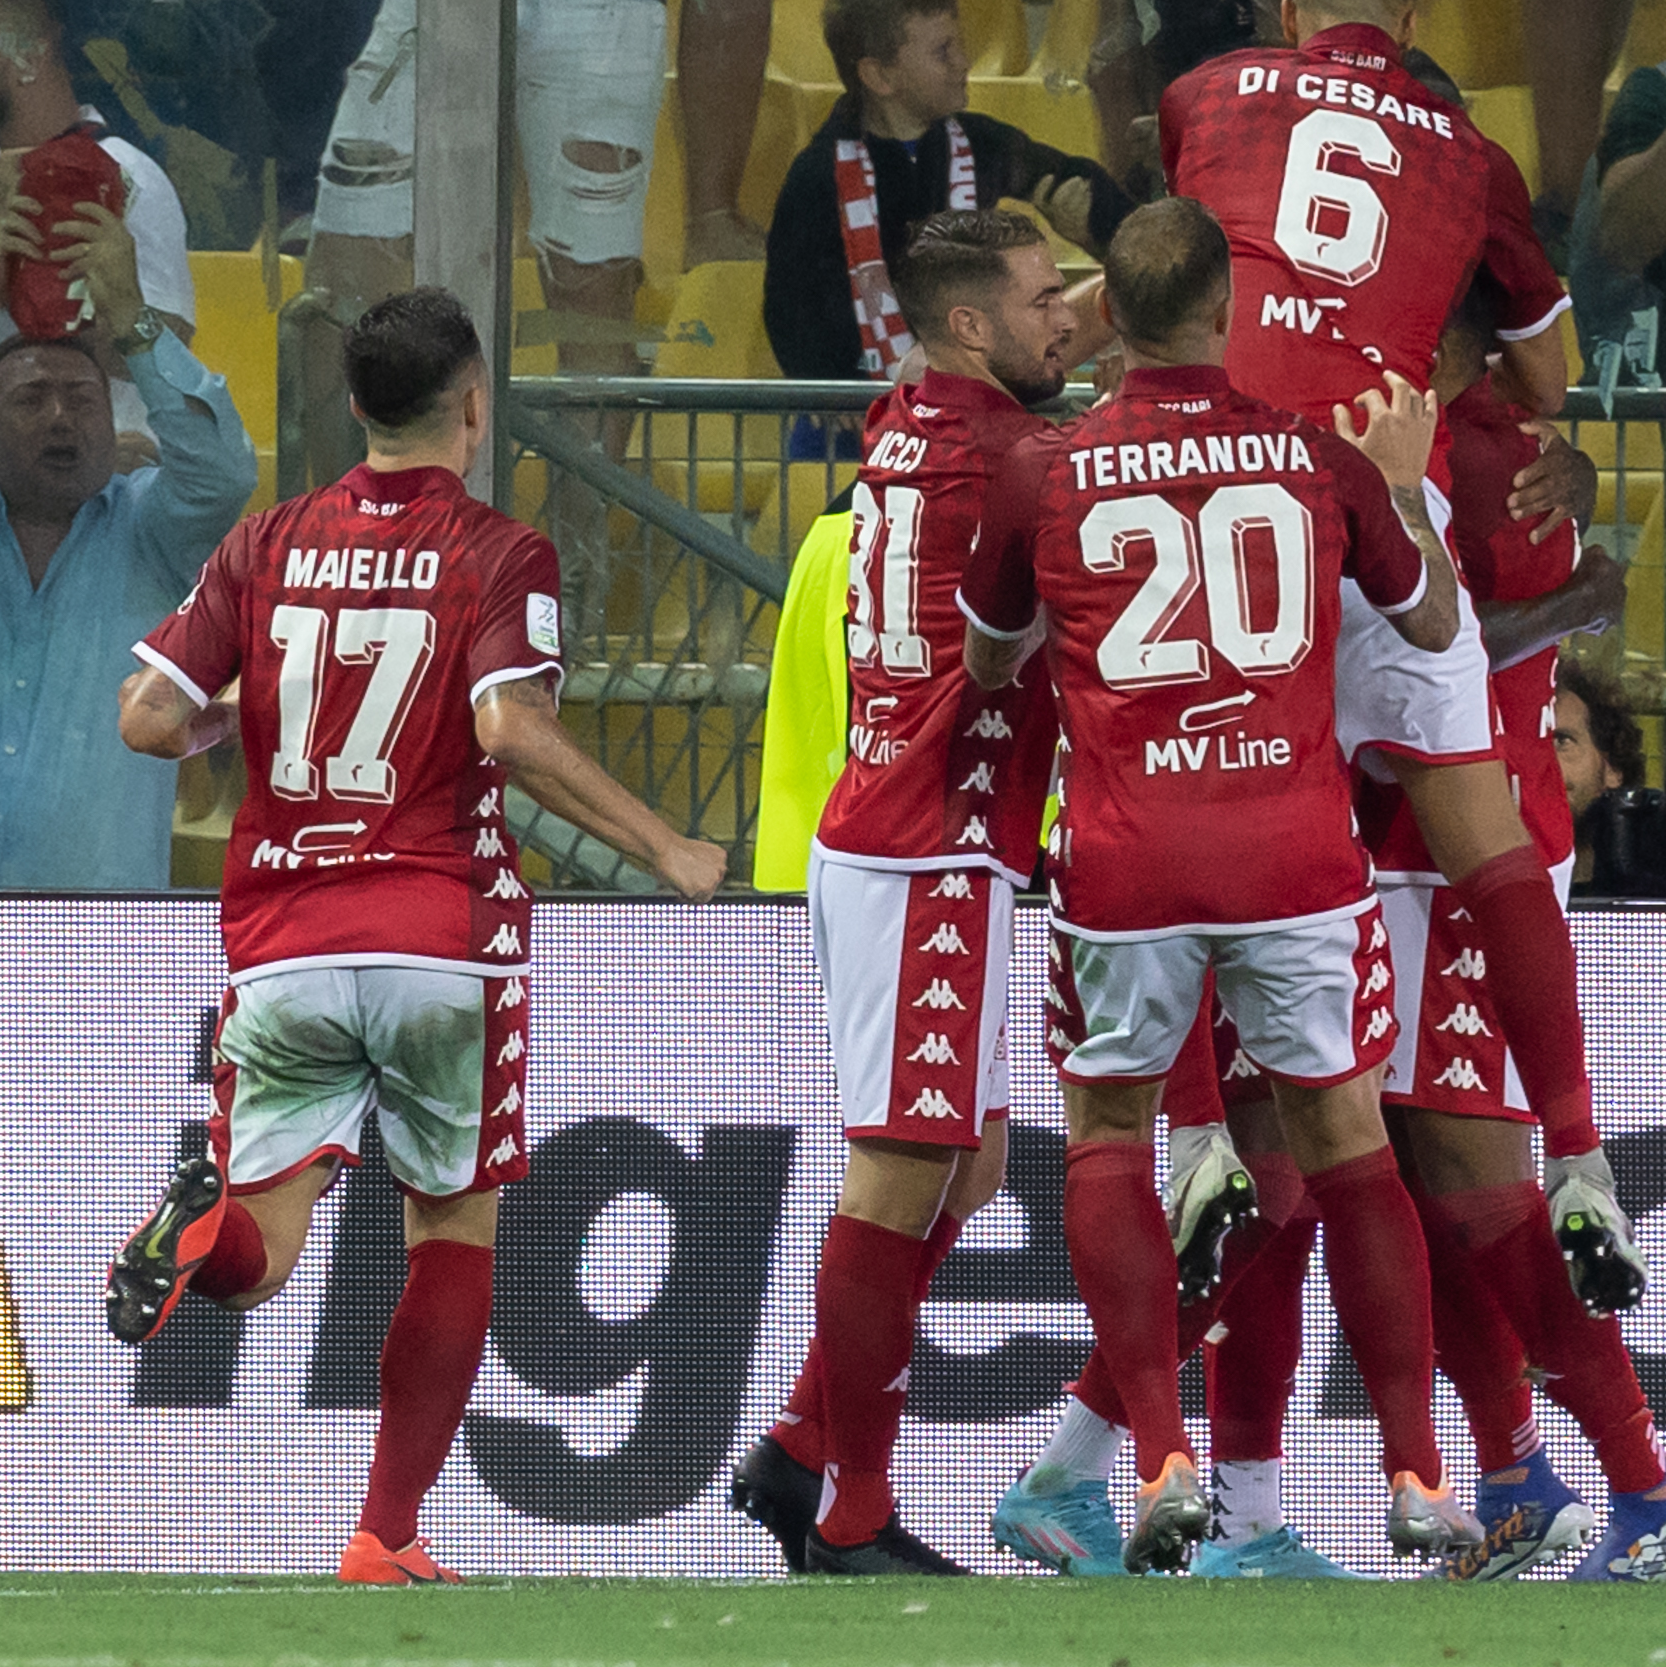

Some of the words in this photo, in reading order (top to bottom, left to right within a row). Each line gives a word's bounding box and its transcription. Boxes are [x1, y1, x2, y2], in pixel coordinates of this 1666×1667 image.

[1238, 66, 1280, 96] DI
[1296, 73, 1454, 140] CESARE
[1273, 108, 1402, 287] 6
[1260, 293, 1323, 334] MV
[1069, 433, 1315, 490] TERRANOVA
[283, 547, 440, 590] MAIELLO
[1078, 482, 1315, 691] 20
[269, 603, 436, 805] 17
[1145, 736, 1210, 775] MV
[1219, 731, 1291, 770] Line
